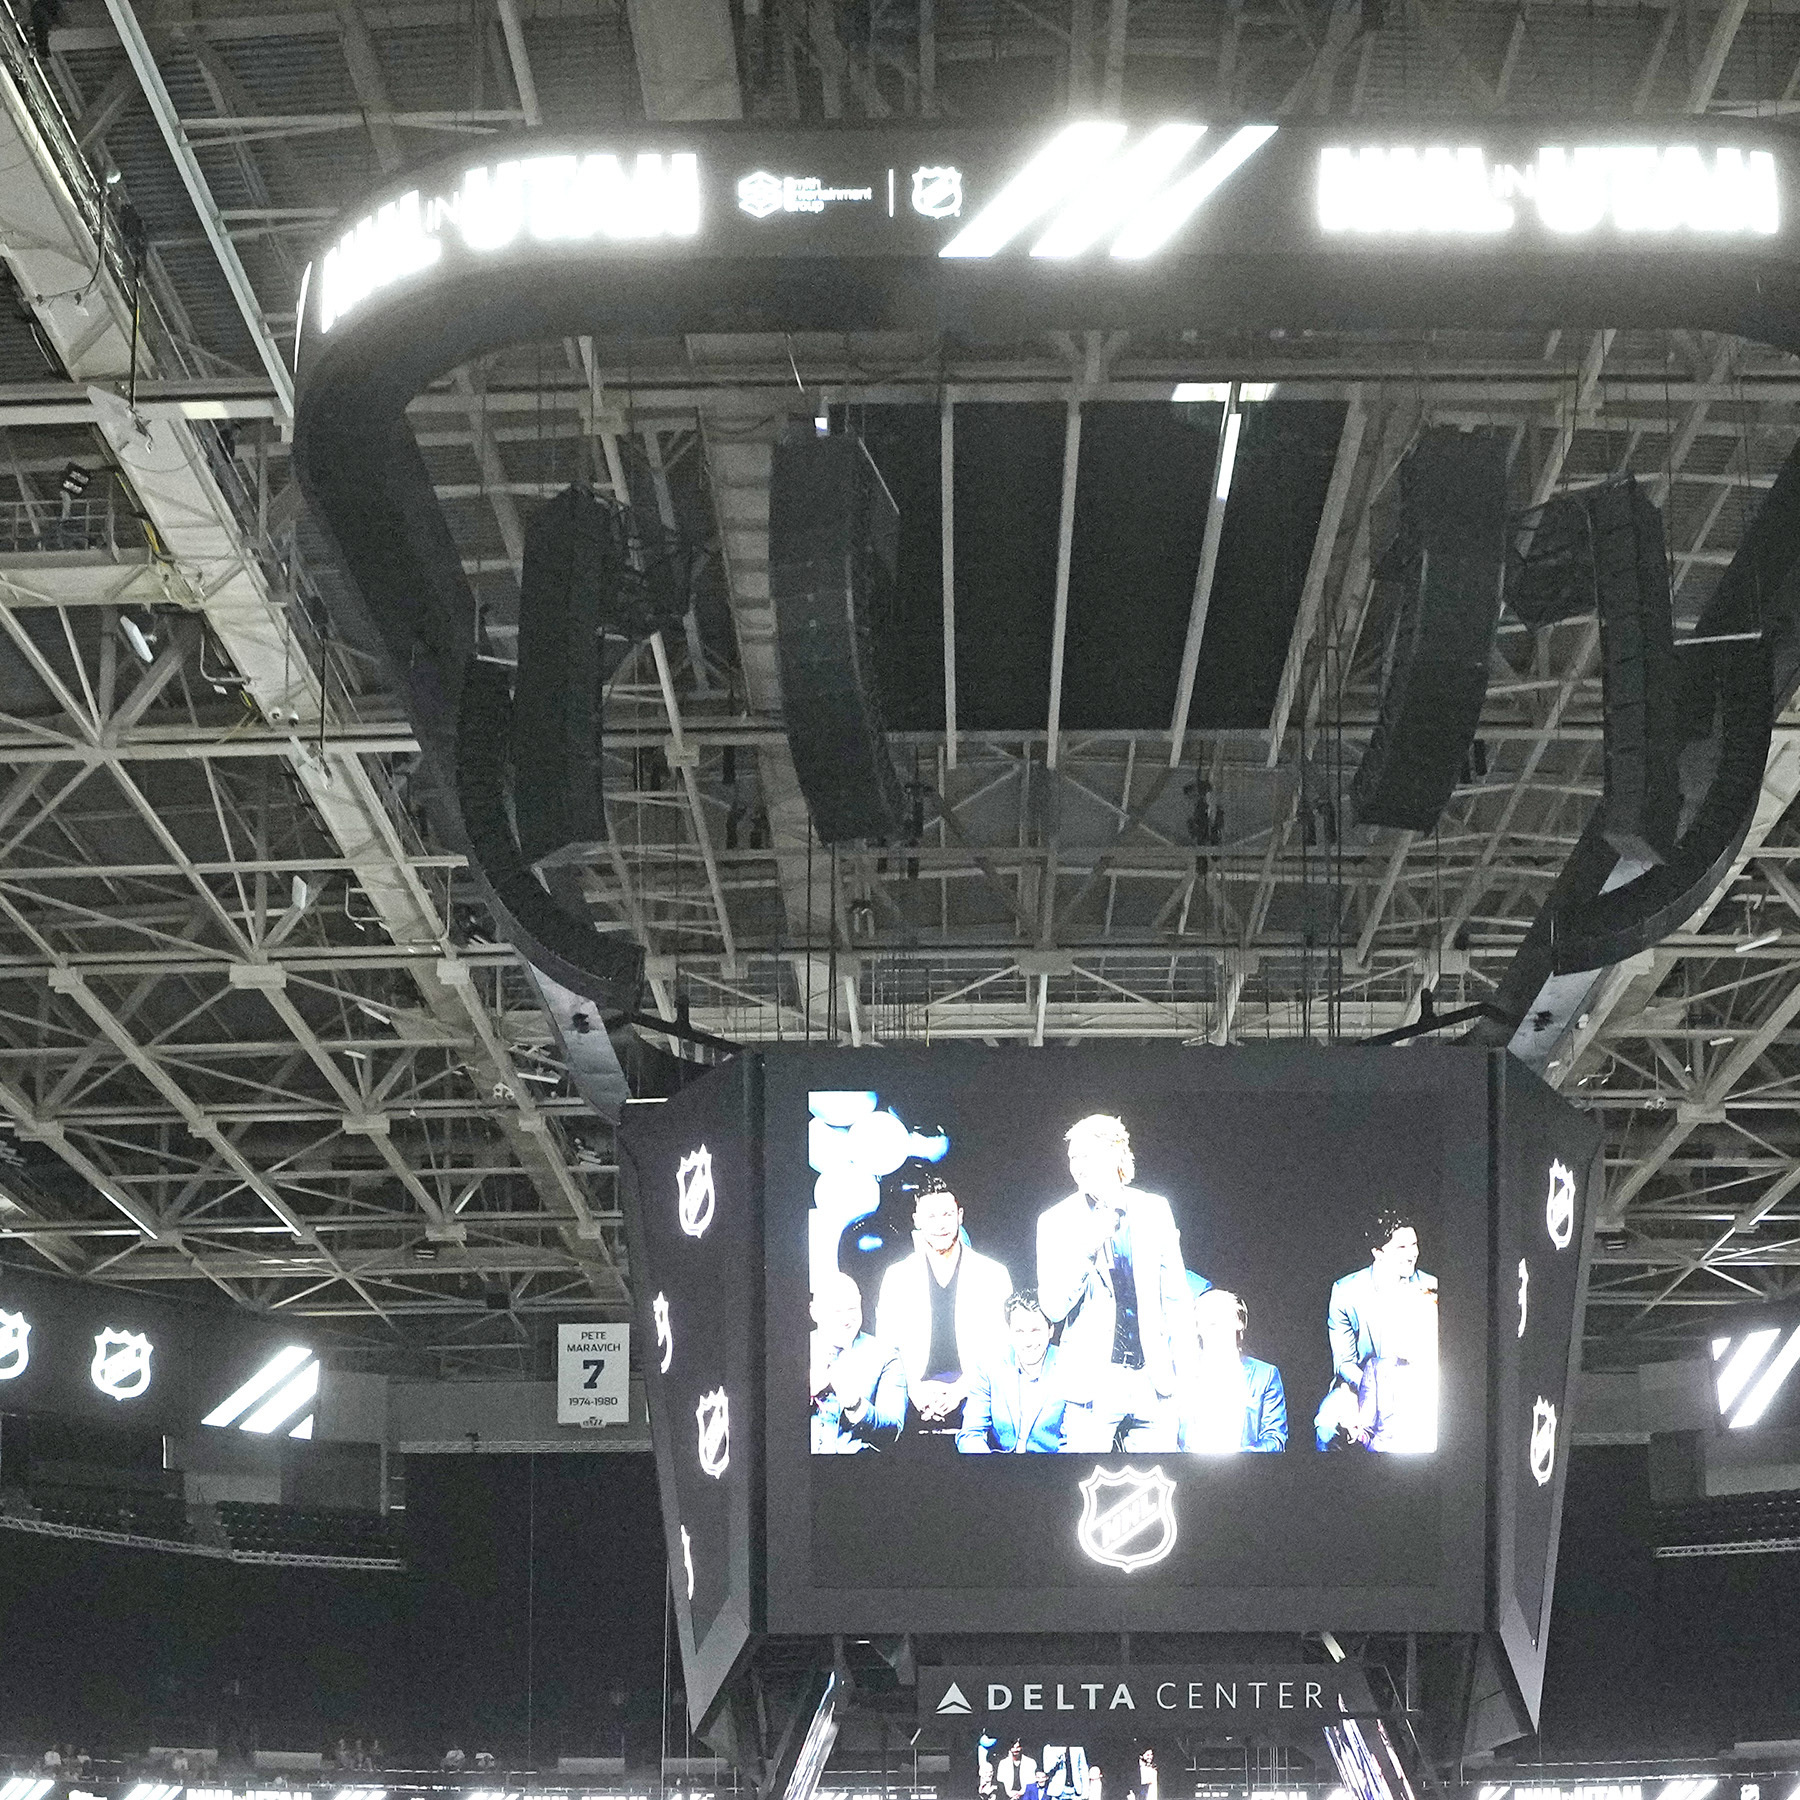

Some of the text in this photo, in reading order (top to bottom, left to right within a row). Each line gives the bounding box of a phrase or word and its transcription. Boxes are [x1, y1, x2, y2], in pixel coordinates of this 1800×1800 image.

[581, 1331, 606, 1340] PETE
[567, 1343, 620, 1353] MARAVICH
[583, 1359, 604, 1389] 7
[569, 1397, 618, 1406] 1974-1980
[987, 1682, 1324, 1711] DELTA CENTER
